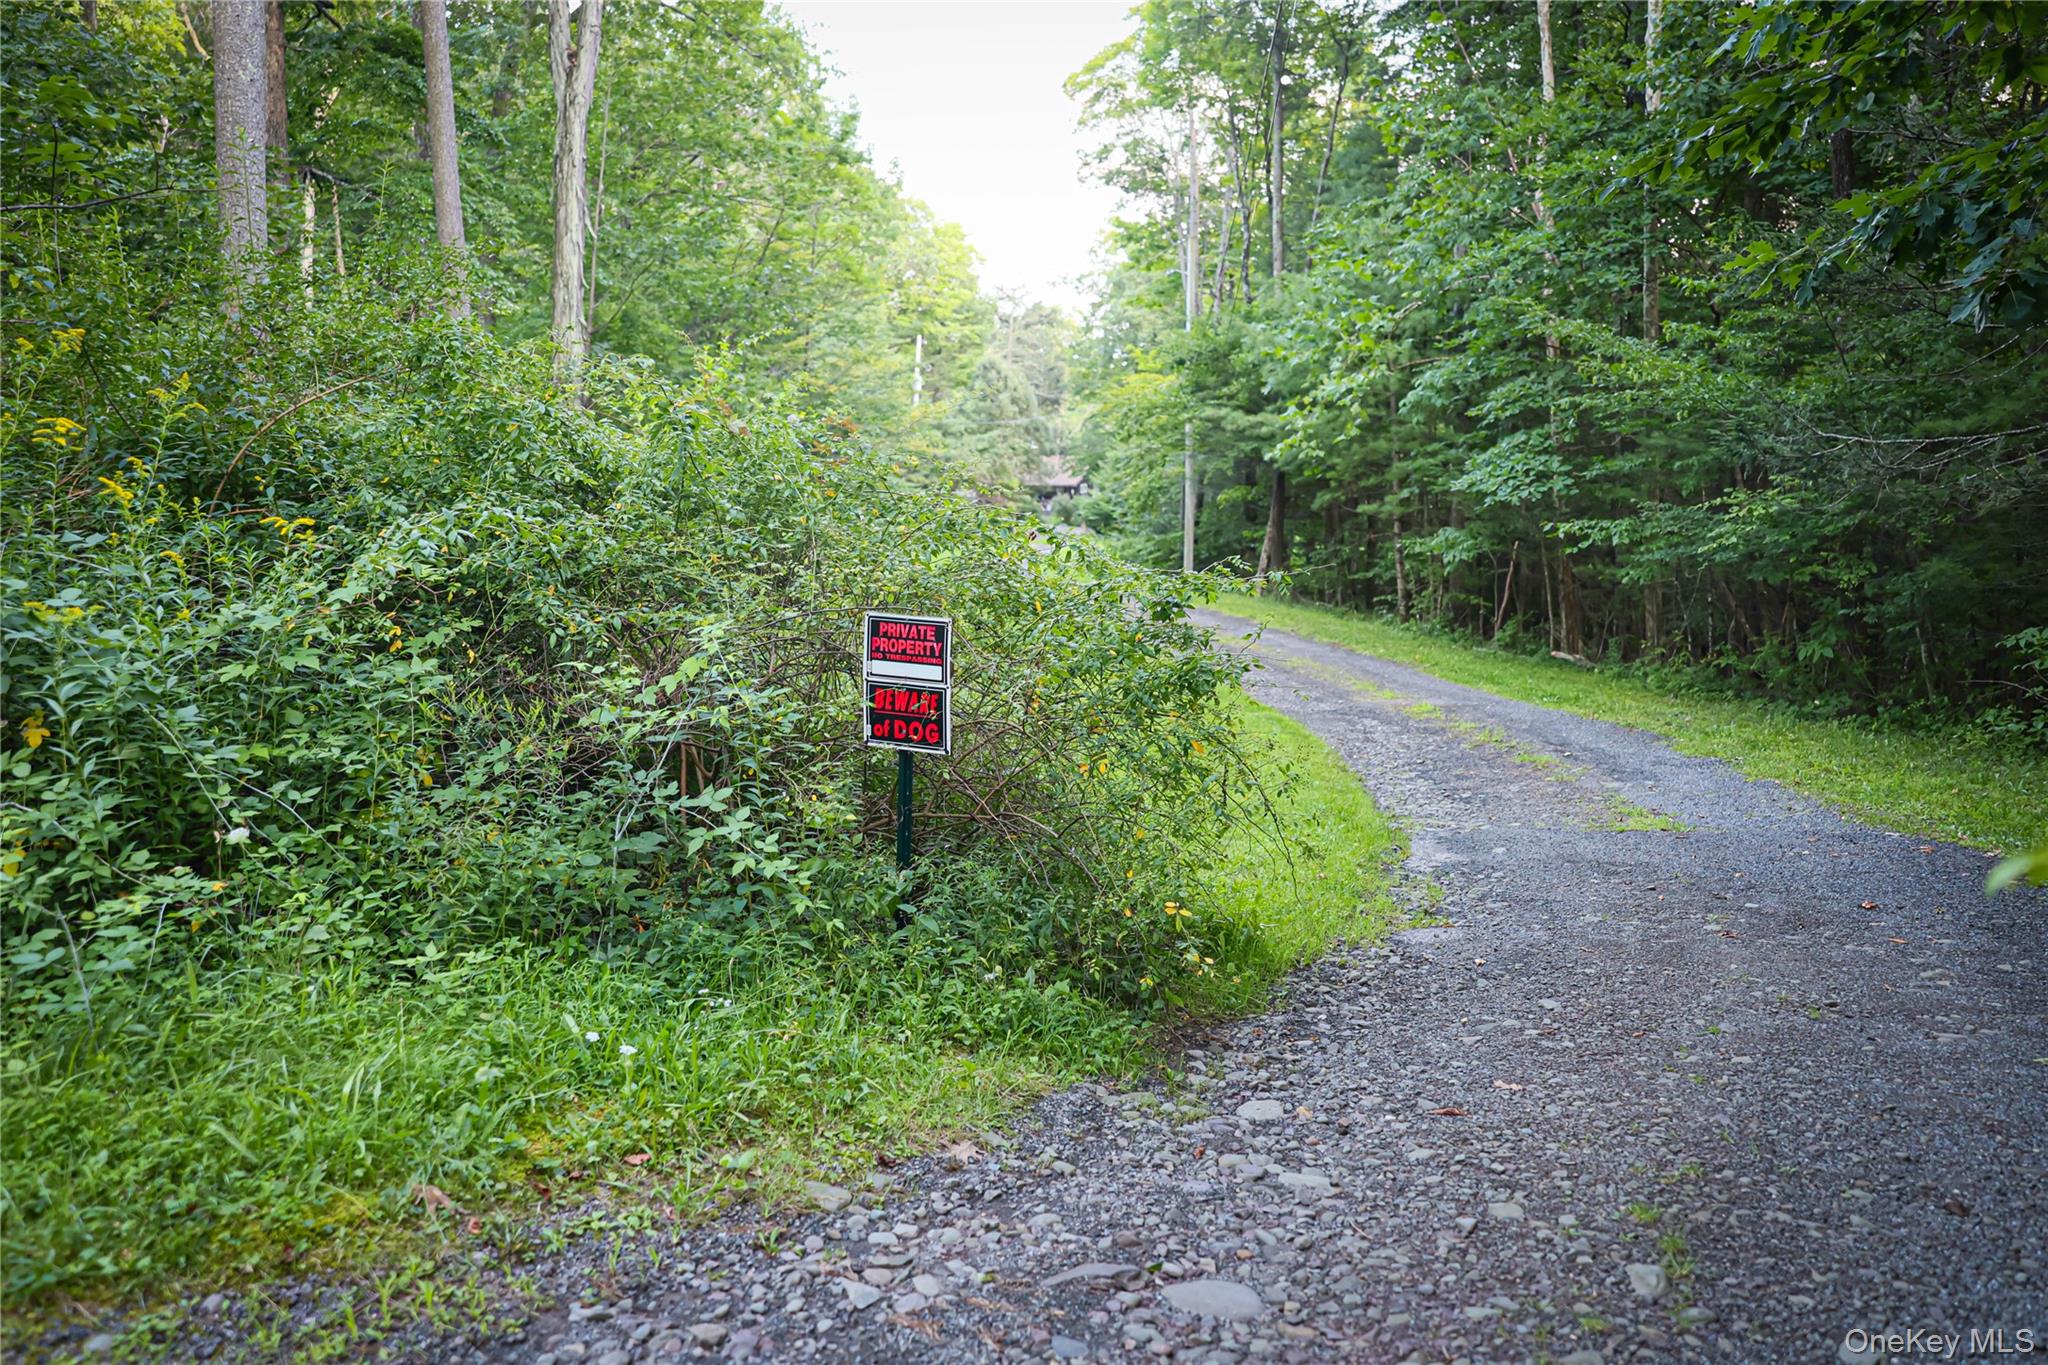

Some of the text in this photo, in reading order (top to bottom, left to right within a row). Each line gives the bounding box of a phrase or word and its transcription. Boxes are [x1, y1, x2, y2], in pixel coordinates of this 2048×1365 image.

[880, 622, 936, 640] PRIVATE
[872, 637, 942, 656] PROPERTY
[886, 653, 942, 664] TRESPASSING
[874, 687, 939, 714] BEWARE
[873, 719, 939, 744] of DOG
